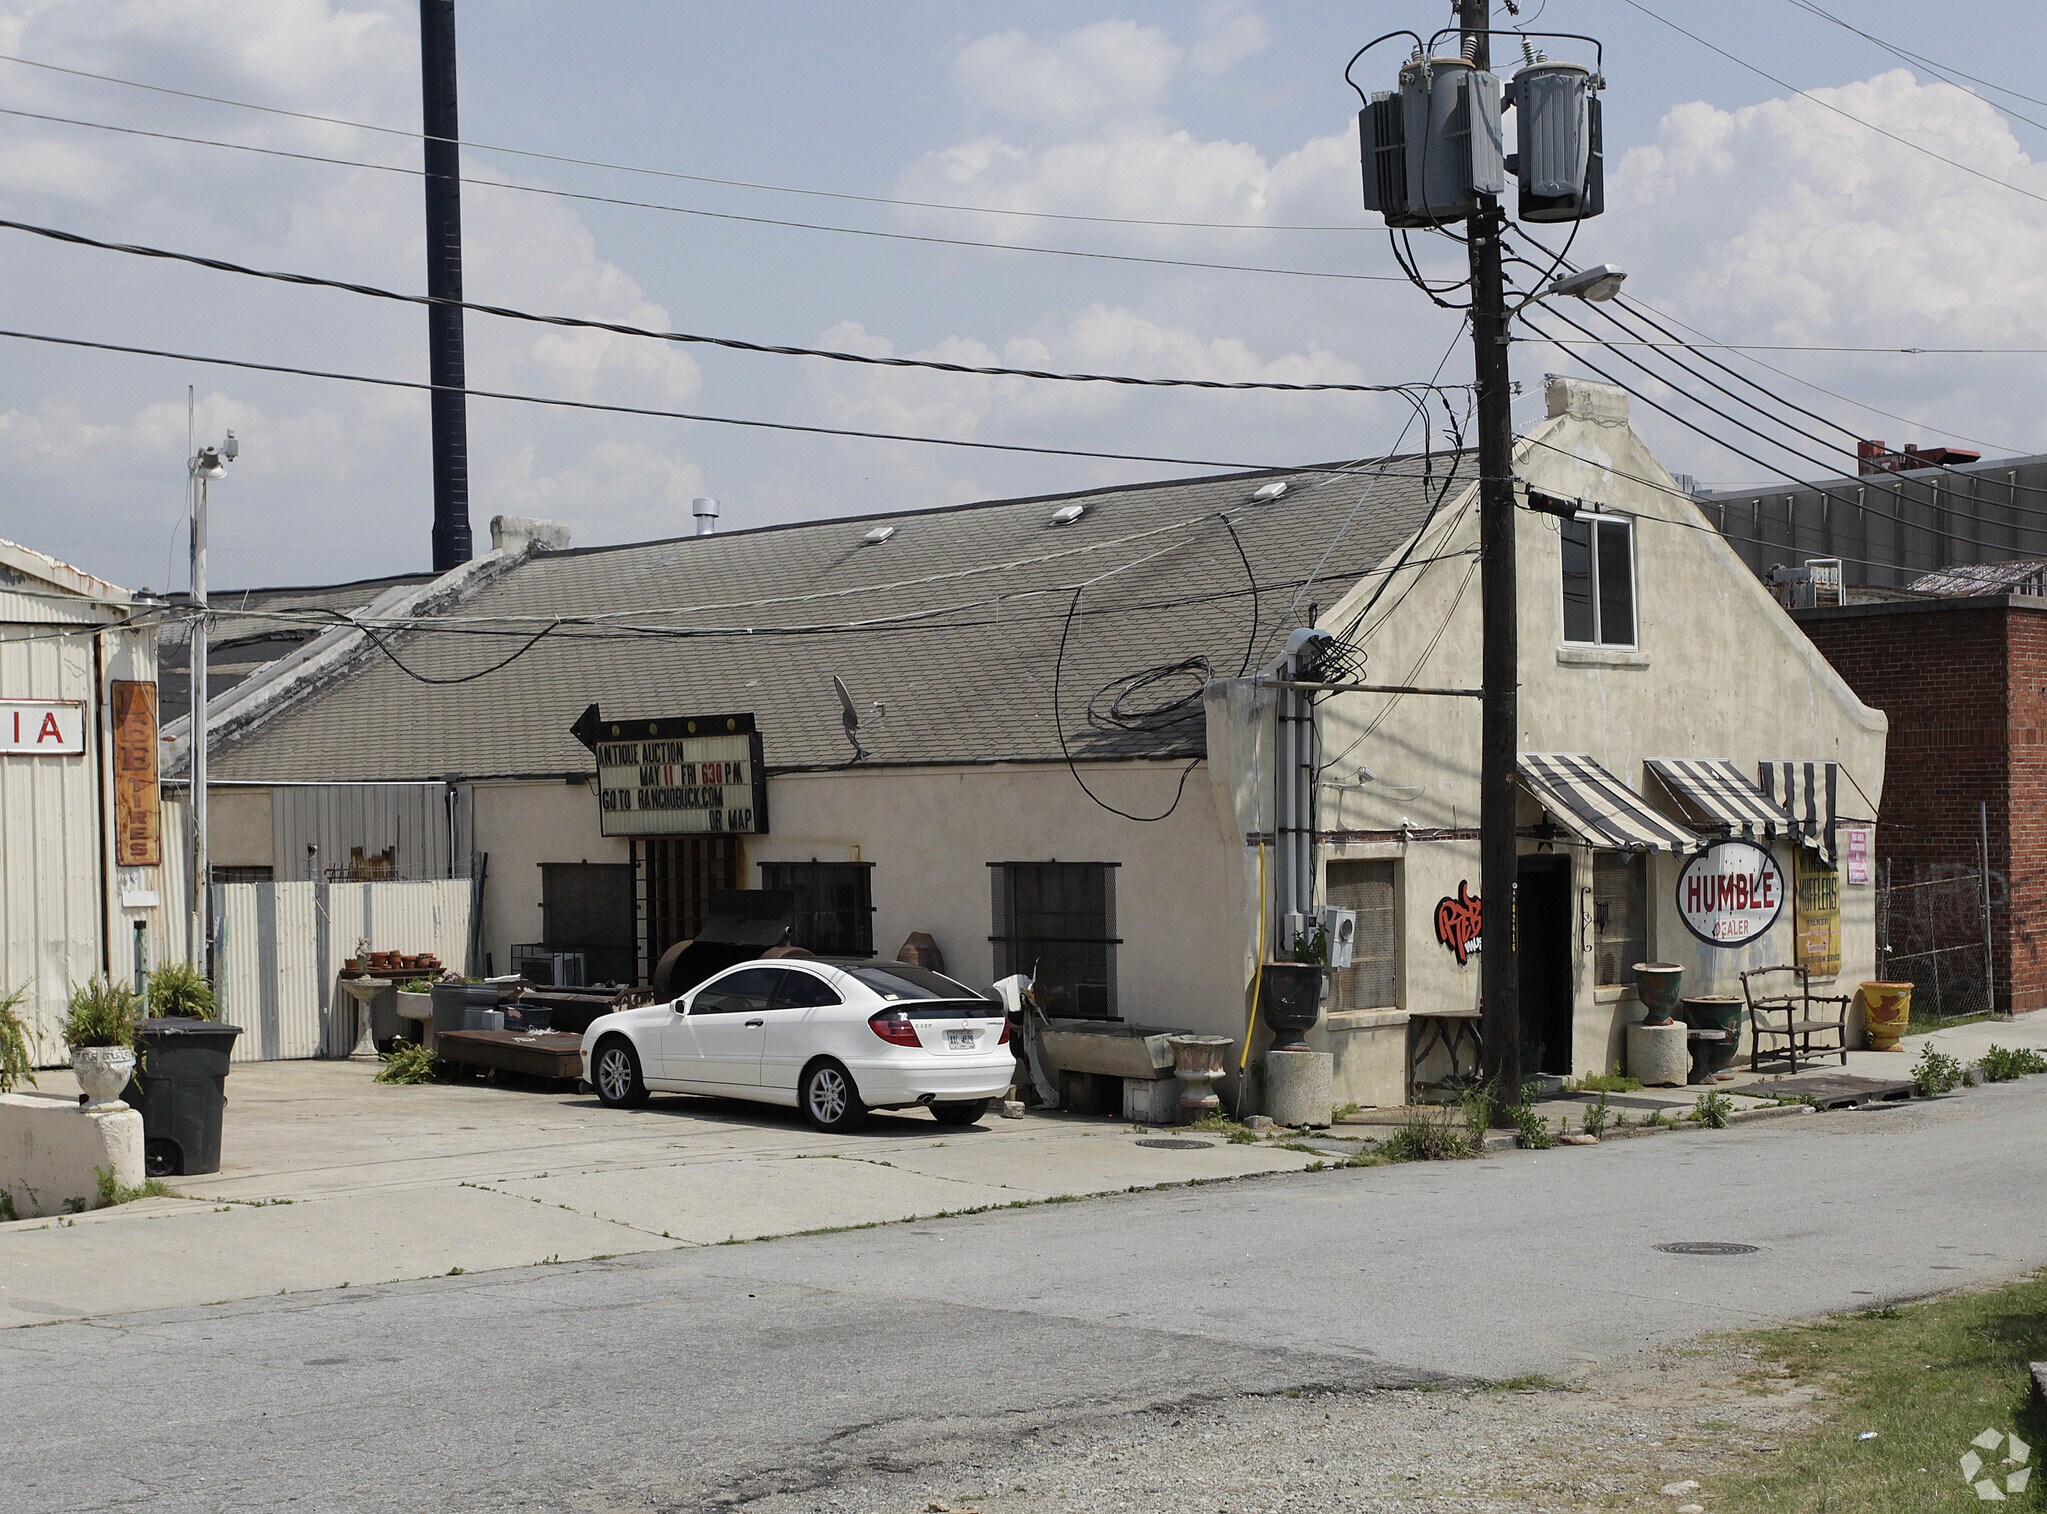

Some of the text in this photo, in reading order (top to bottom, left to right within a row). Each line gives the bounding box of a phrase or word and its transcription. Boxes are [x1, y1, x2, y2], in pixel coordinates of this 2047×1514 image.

[642, 742, 684, 763] AUCTION
[640, 765, 660, 786] MAY
[681, 764, 697, 785] FRI
[702, 763, 723, 784] 630
[603, 790, 616, 809] GO
[619, 789, 631, 809] TO
[727, 808, 752, 831] MAP
[1687, 871, 1775, 914] HUMBLE
[1799, 877, 1837, 912] MUFFLERS
[1713, 919, 1749, 939] DEALER
